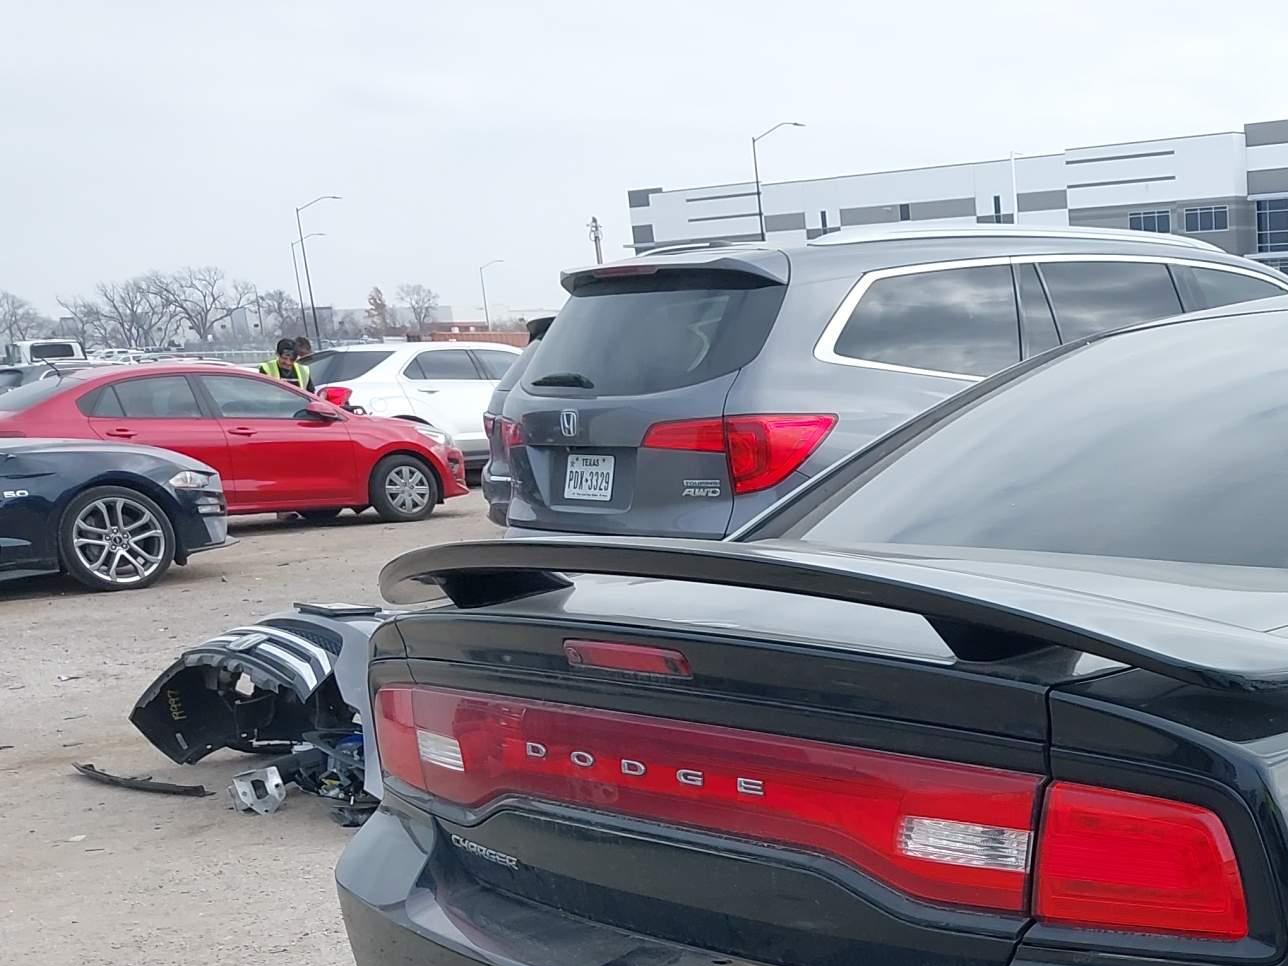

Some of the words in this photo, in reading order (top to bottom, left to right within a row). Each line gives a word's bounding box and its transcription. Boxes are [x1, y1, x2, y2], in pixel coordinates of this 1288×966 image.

[582, 458, 599, 467] TEXAS
[682, 488, 720, 497] AWD
[526, 742, 764, 796] DODGE
[451, 833, 519, 871] CHARGER
